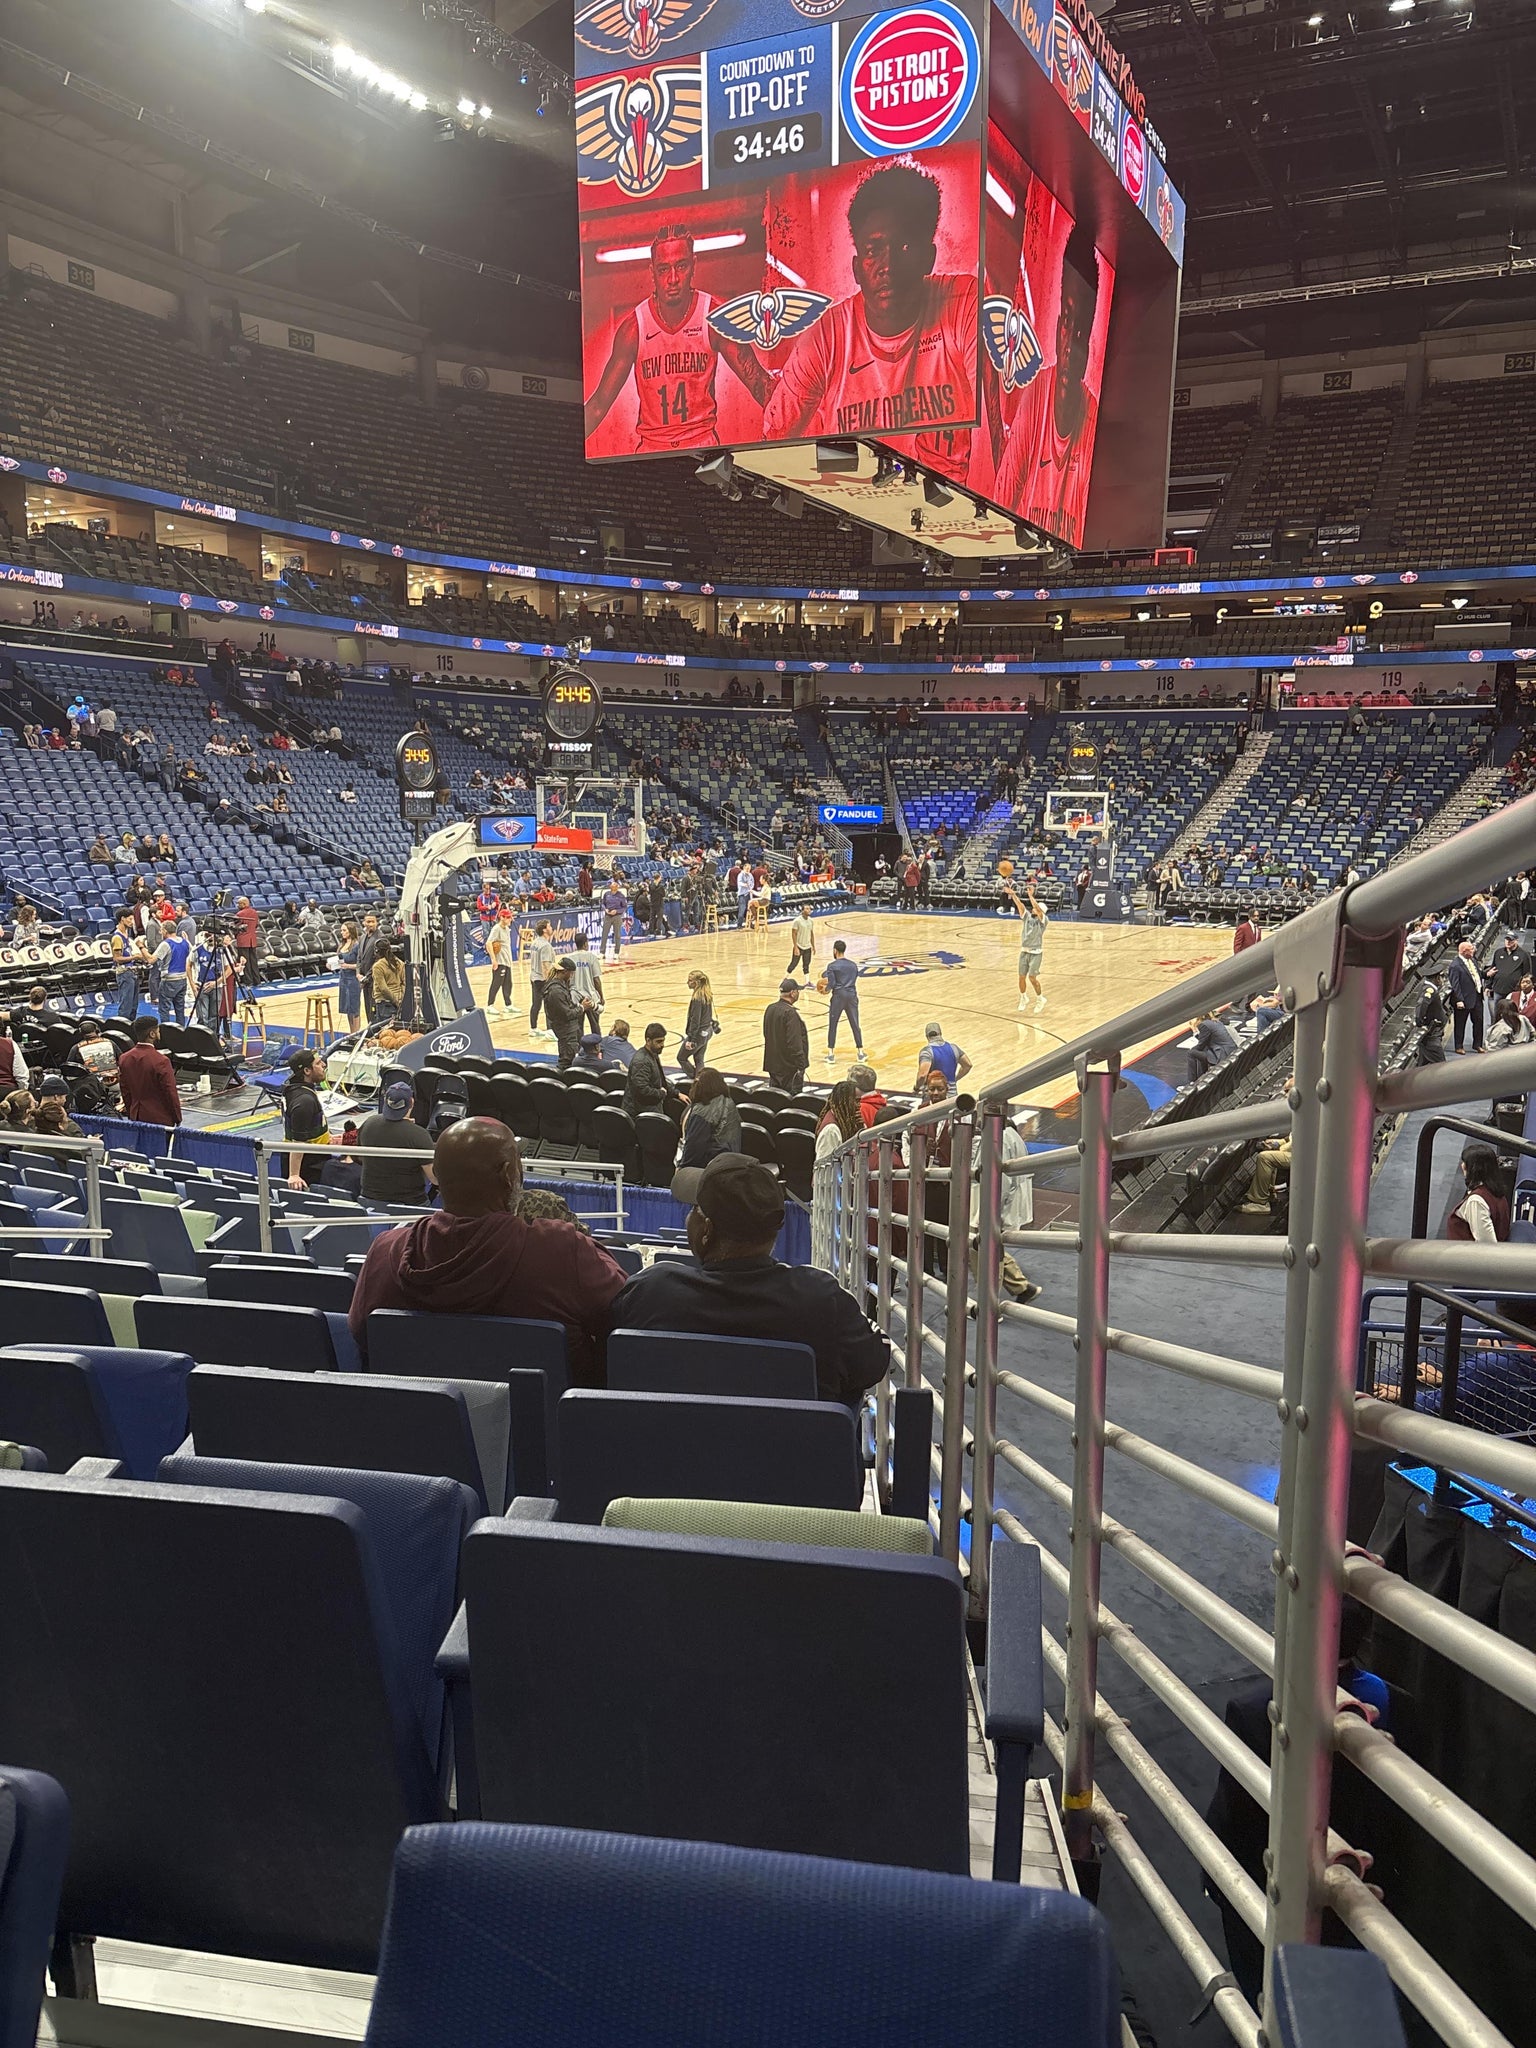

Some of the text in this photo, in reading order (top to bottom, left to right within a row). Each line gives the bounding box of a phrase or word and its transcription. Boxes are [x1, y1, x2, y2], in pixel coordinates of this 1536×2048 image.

[720, 45, 815, 82] COUNTDOWN TO
[868, 46, 950, 85] DETROIT
[724, 70, 810, 120] TIP-OFF
[867, 72, 950, 111] PISTONS
[733, 123, 805, 163] 34:46
[1094, 111, 1116, 163] 34:46
[1144, 117, 1167, 164] CENTER
[71, 265, 94, 287] 318
[291, 332, 313, 349] 319
[918, 332, 942, 347] WAGE
[641, 352, 709, 380] NEW ORLEANS
[1505, 355, 1535, 370] 325
[523, 380, 547, 392] 320
[1324, 374, 1350, 389] 324
[657, 381, 689, 425] 14
[1174, 391, 1190, 404] 23
[181, 498, 194, 511] New
[195, 502, 216, 517] Orleans
[8, 568, 37, 585] Orleans
[34, 569, 64, 589] PELICANS
[33, 599, 56, 622] 113
[259, 631, 276, 650] 114
[437, 655, 453, 672] 115
[634, 653, 648, 664] New
[1291, 655, 1307, 667] New
[951, 663, 965, 674] New
[663, 672, 680, 688] 116
[920, 680, 938, 694] 117
[1156, 675, 1175, 691] 118
[1381, 671, 1402, 687] 119
[555, 686, 591, 703] 34:45
[404, 748, 430, 763] 34:45
[560, 743, 593, 752] TISSOT
[414, 791, 435, 799] TISSOT
[838, 810, 878, 819] FANDUEL
[1093, 893, 1106, 907] G
[450, 913, 463, 989] NEWAGEPRODUCTS.CO
[438, 1034, 465, 1053] Ford
